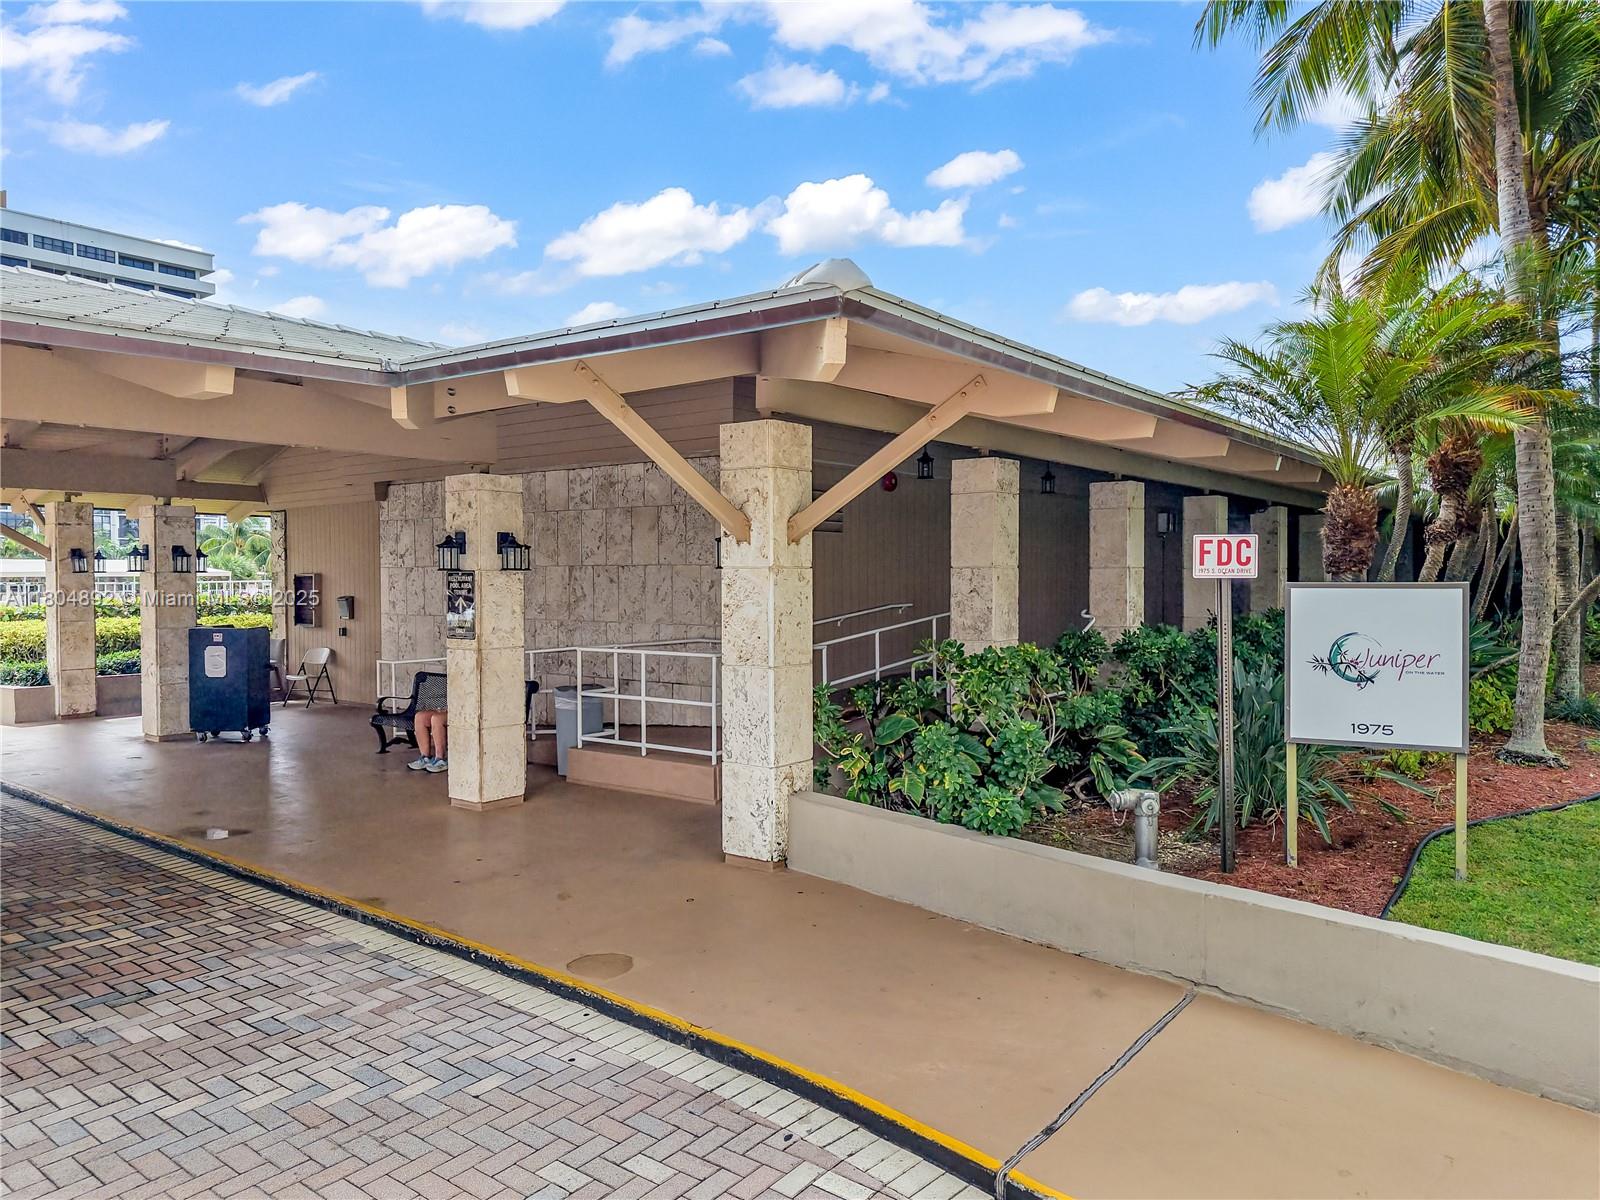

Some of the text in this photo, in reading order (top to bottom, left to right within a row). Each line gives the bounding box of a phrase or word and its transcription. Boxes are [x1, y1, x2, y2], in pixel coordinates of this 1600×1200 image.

[1199, 539, 1251, 566] FDC
[1217, 567, 1235, 575] OCEAN
[1360, 647, 1441, 681] Juniper
[1351, 723, 1394, 736] 1975
